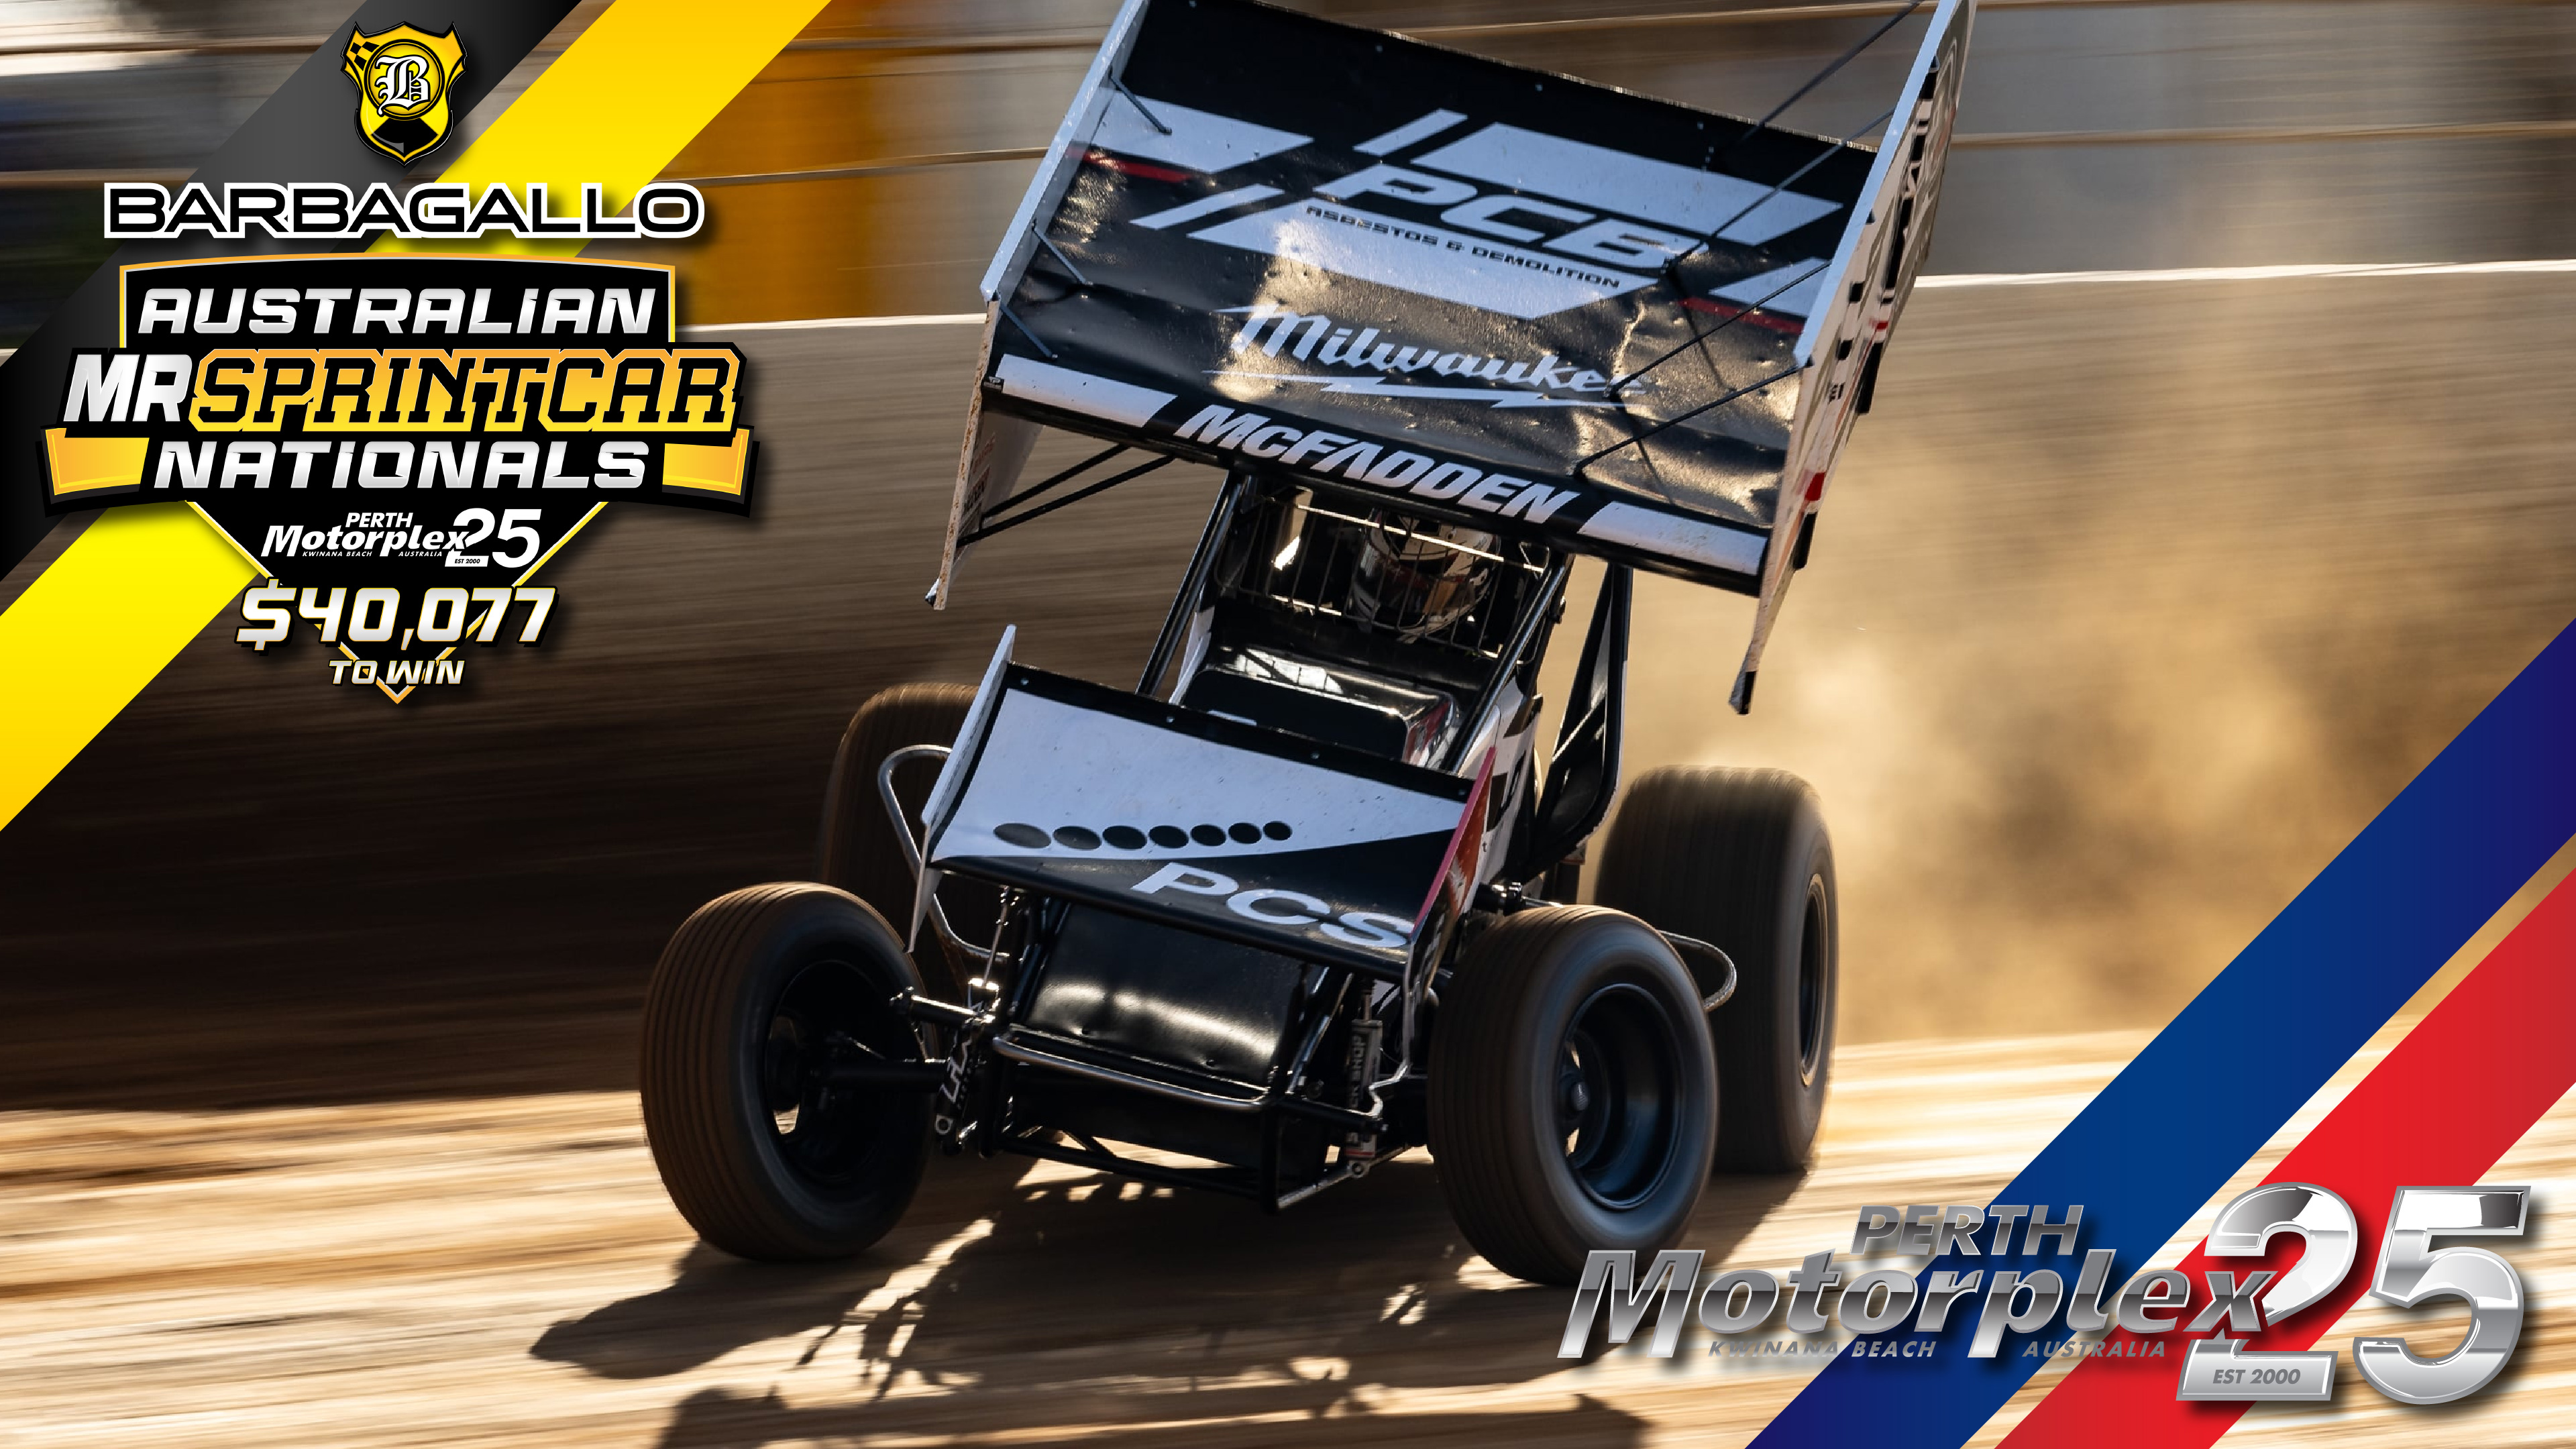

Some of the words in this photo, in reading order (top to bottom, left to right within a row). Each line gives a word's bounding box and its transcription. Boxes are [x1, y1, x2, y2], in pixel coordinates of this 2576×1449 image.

[1306, 205, 1438, 246] ASBESTOS
[1446, 239, 1464, 253] &
[1472, 246, 1620, 288] DEMOLITION
[1313, 164, 1709, 268] PCB
[1213, 303, 1653, 394] Milwaukee
[1131, 862, 1414, 947] PCS
